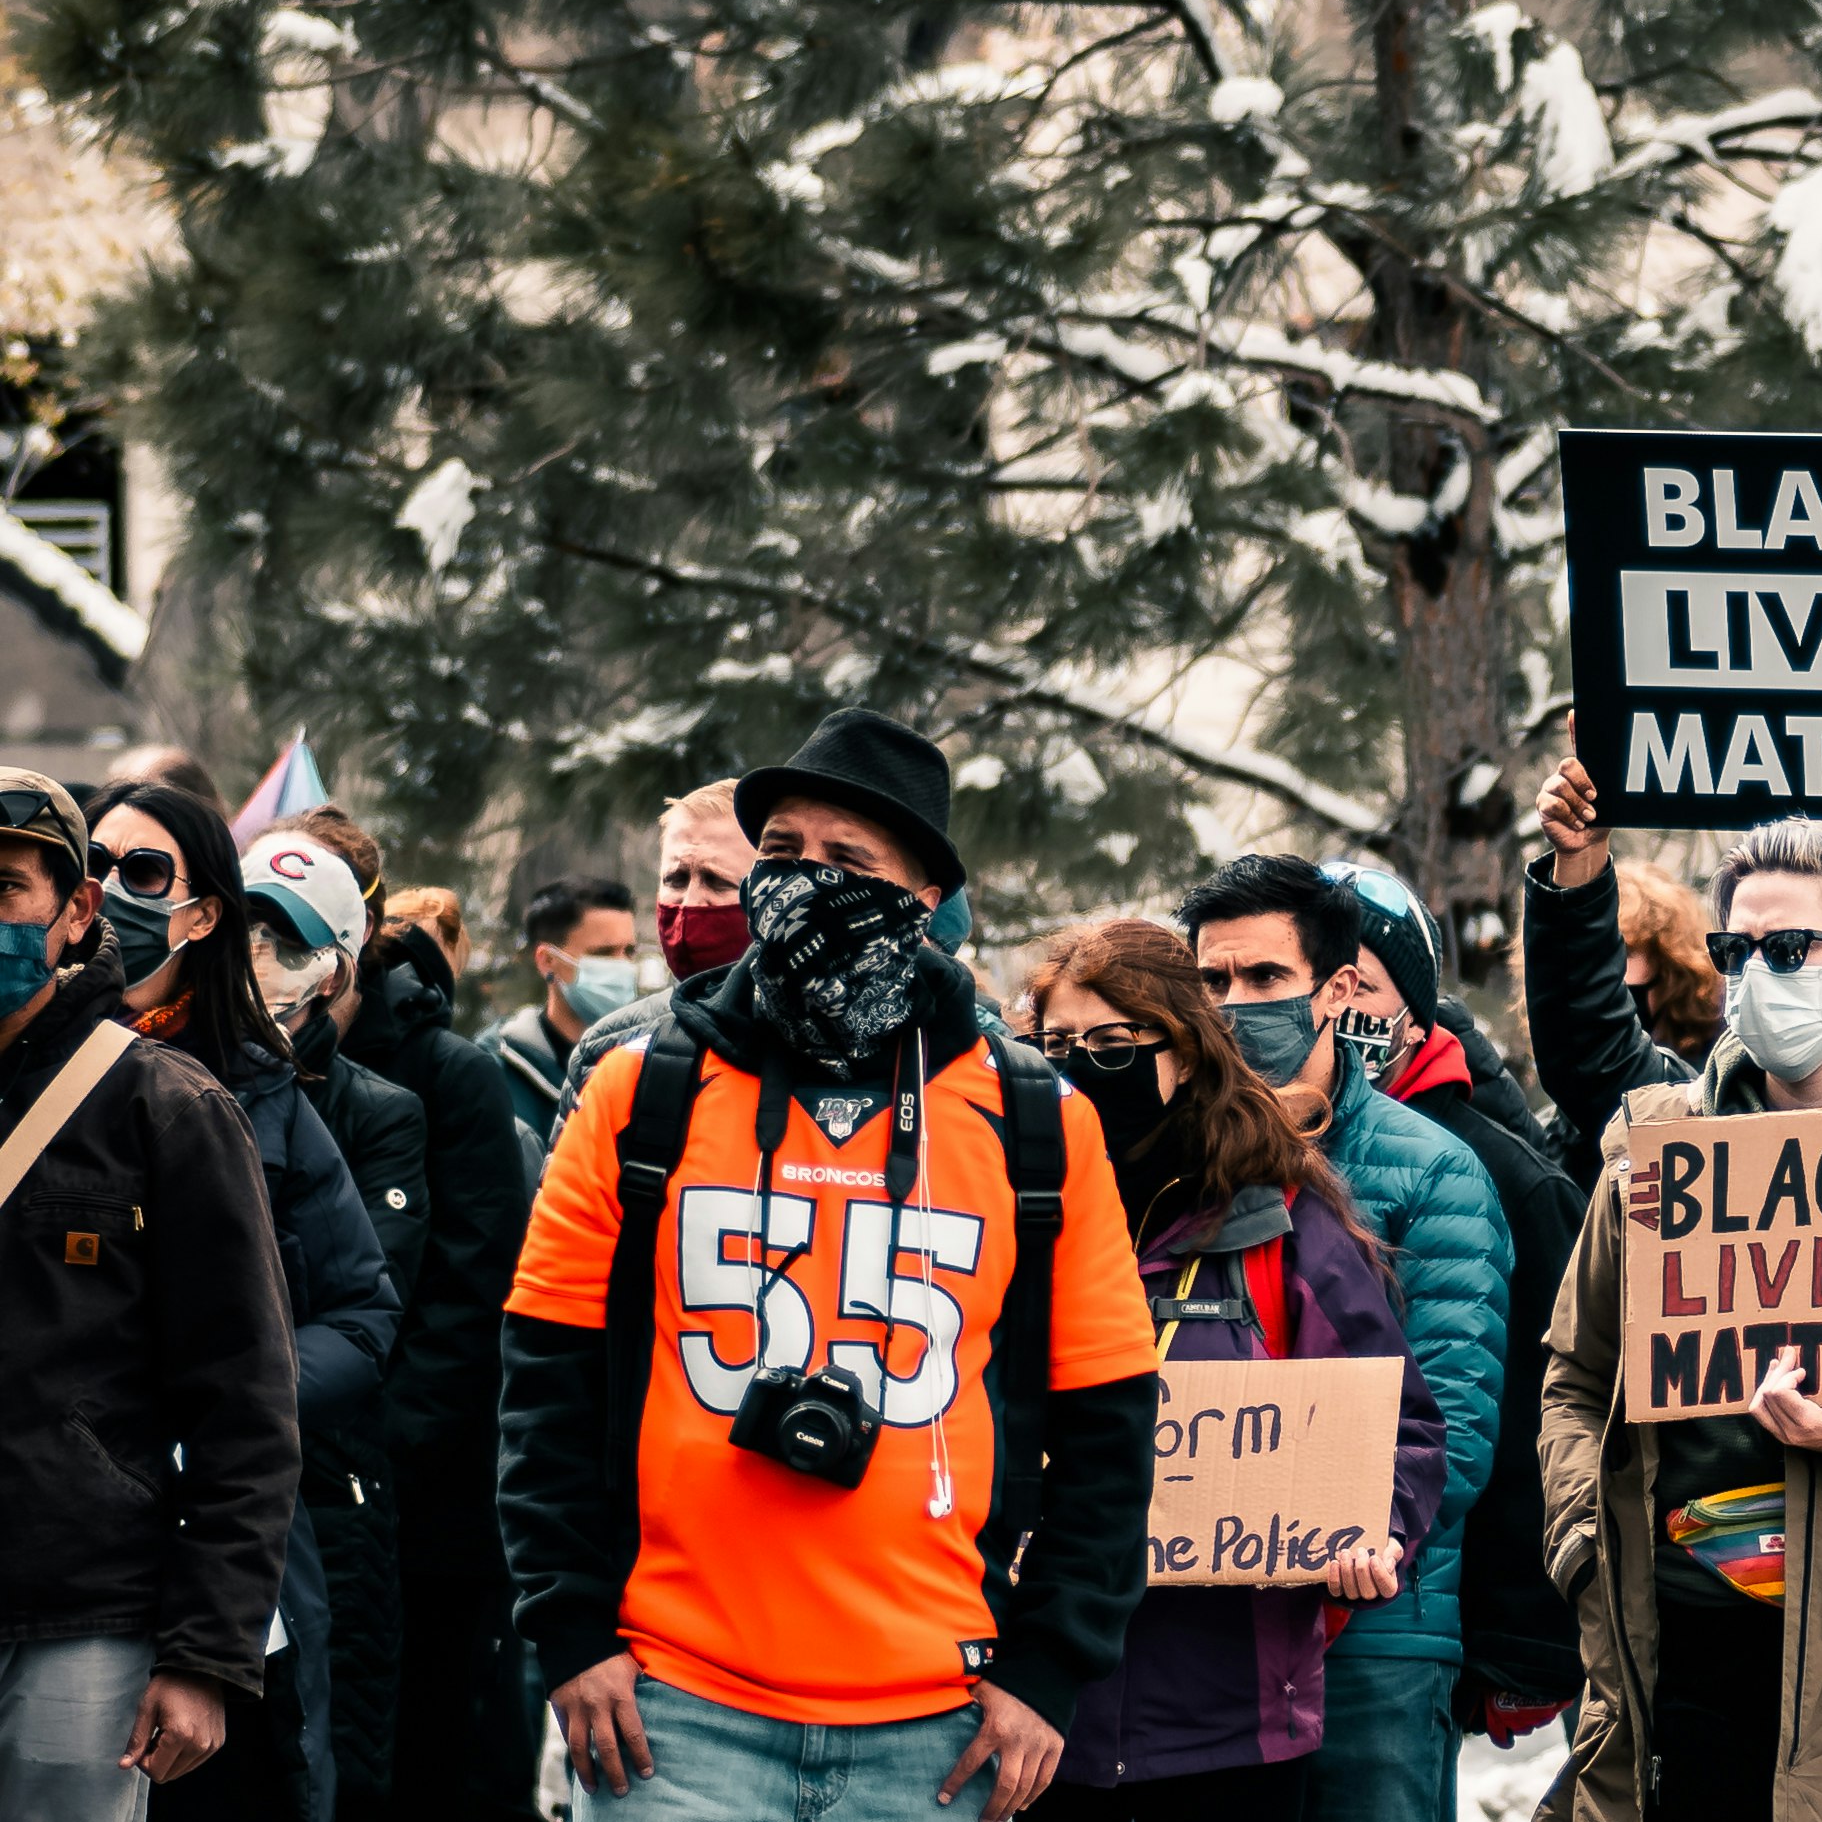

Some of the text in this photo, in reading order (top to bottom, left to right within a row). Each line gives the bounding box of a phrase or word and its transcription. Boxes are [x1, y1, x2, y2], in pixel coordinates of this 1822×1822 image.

[269, 850, 315, 881] C
[900, 1092, 915, 1132] EOS
[781, 1164, 886, 1188] BRONCOS
[1628, 1160, 1661, 1232] ALL
[678, 1185, 985, 1429] 55
[821, 1375, 850, 1392] Canon
[796, 1431, 825, 1448] Canon
